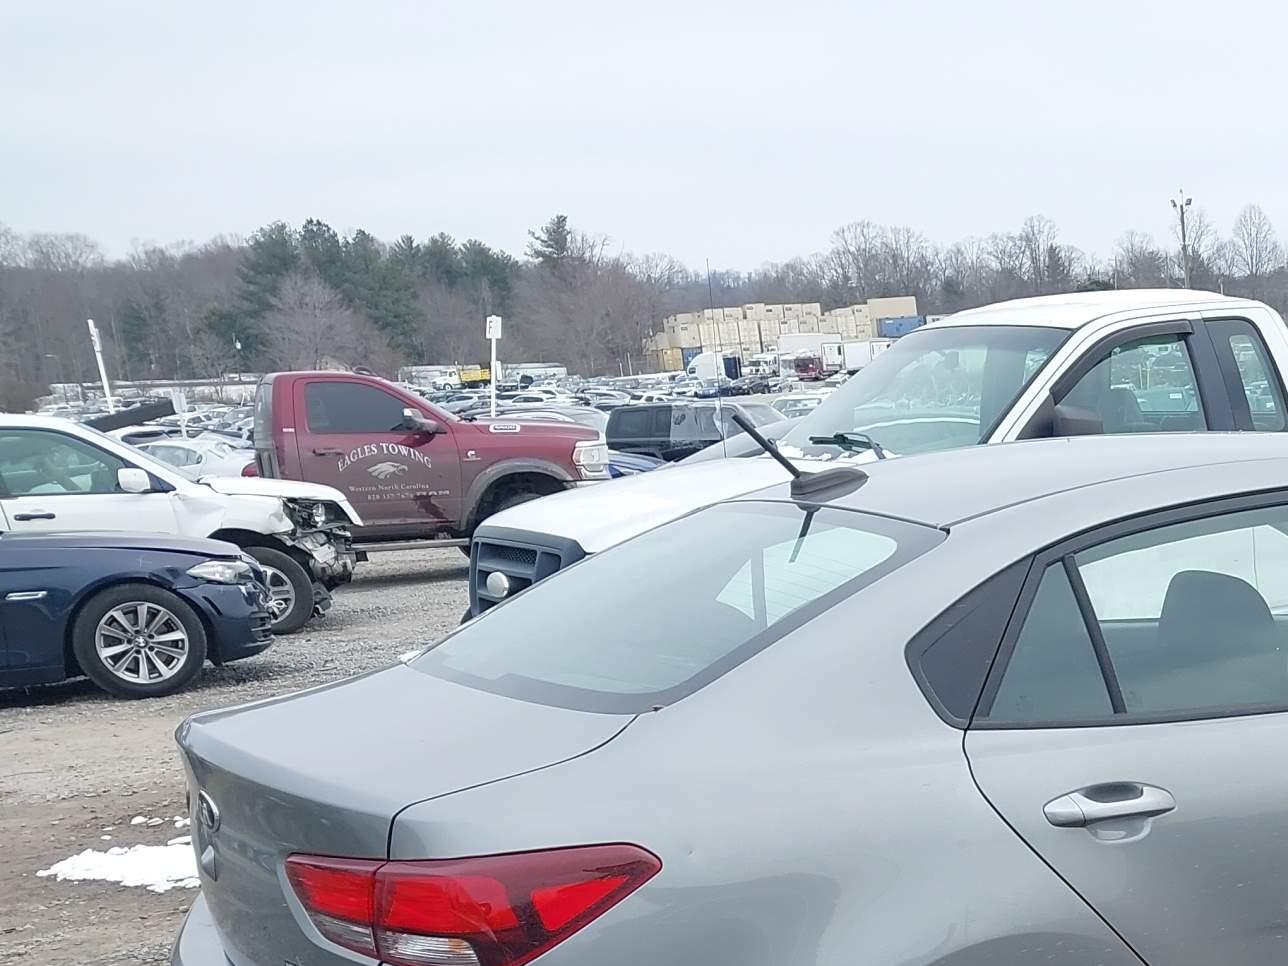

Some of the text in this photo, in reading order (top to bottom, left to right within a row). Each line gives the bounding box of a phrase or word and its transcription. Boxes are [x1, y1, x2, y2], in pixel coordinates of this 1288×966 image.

[337, 442, 432, 472] EAGLES TOWING
[378, 483, 399, 491] North
[400, 482, 430, 490] Carolina
